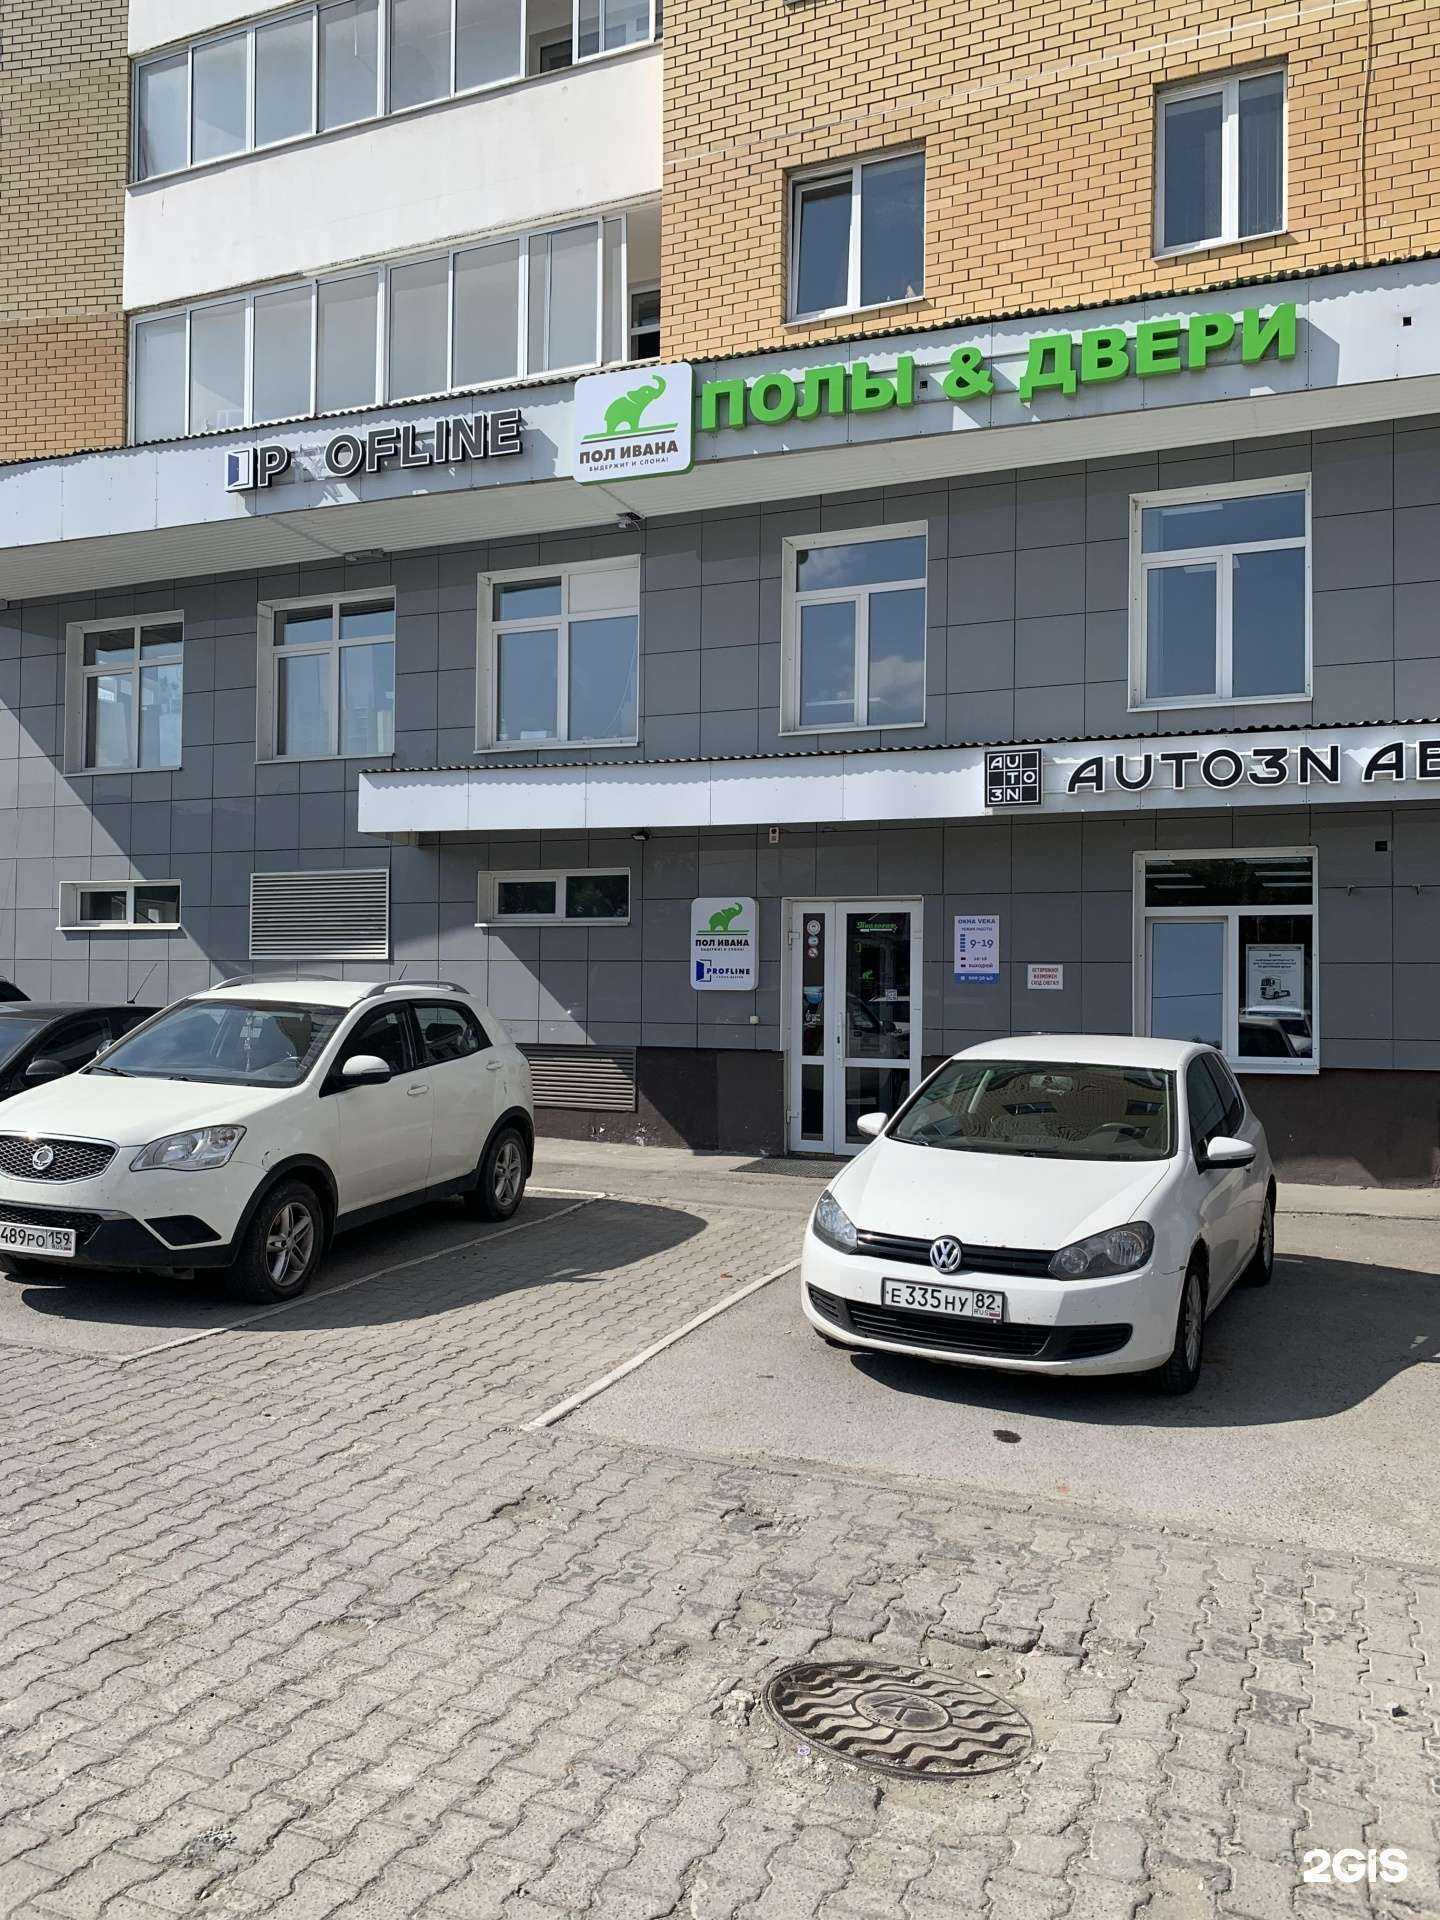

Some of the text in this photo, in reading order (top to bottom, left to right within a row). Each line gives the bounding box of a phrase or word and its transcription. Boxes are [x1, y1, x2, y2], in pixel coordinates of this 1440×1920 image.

[701, 303, 1297, 432] ПОЛЫ & ДВЕРИ
[579, 440, 679, 465] ПОЛ ИВАНА
[589, 461, 630, 472] ВЫДЕРЖИТ
[1066, 745, 1341, 794] AUTO3N
[695, 939, 750, 947] ПОЛ ИВАНА
[969, 939, 994, 949] 9-19
[706, 967, 750, 975] PROFLINE
[48, 1231, 70, 1246] 159
[891, 1285, 996, 1312] Е335НУ 82
